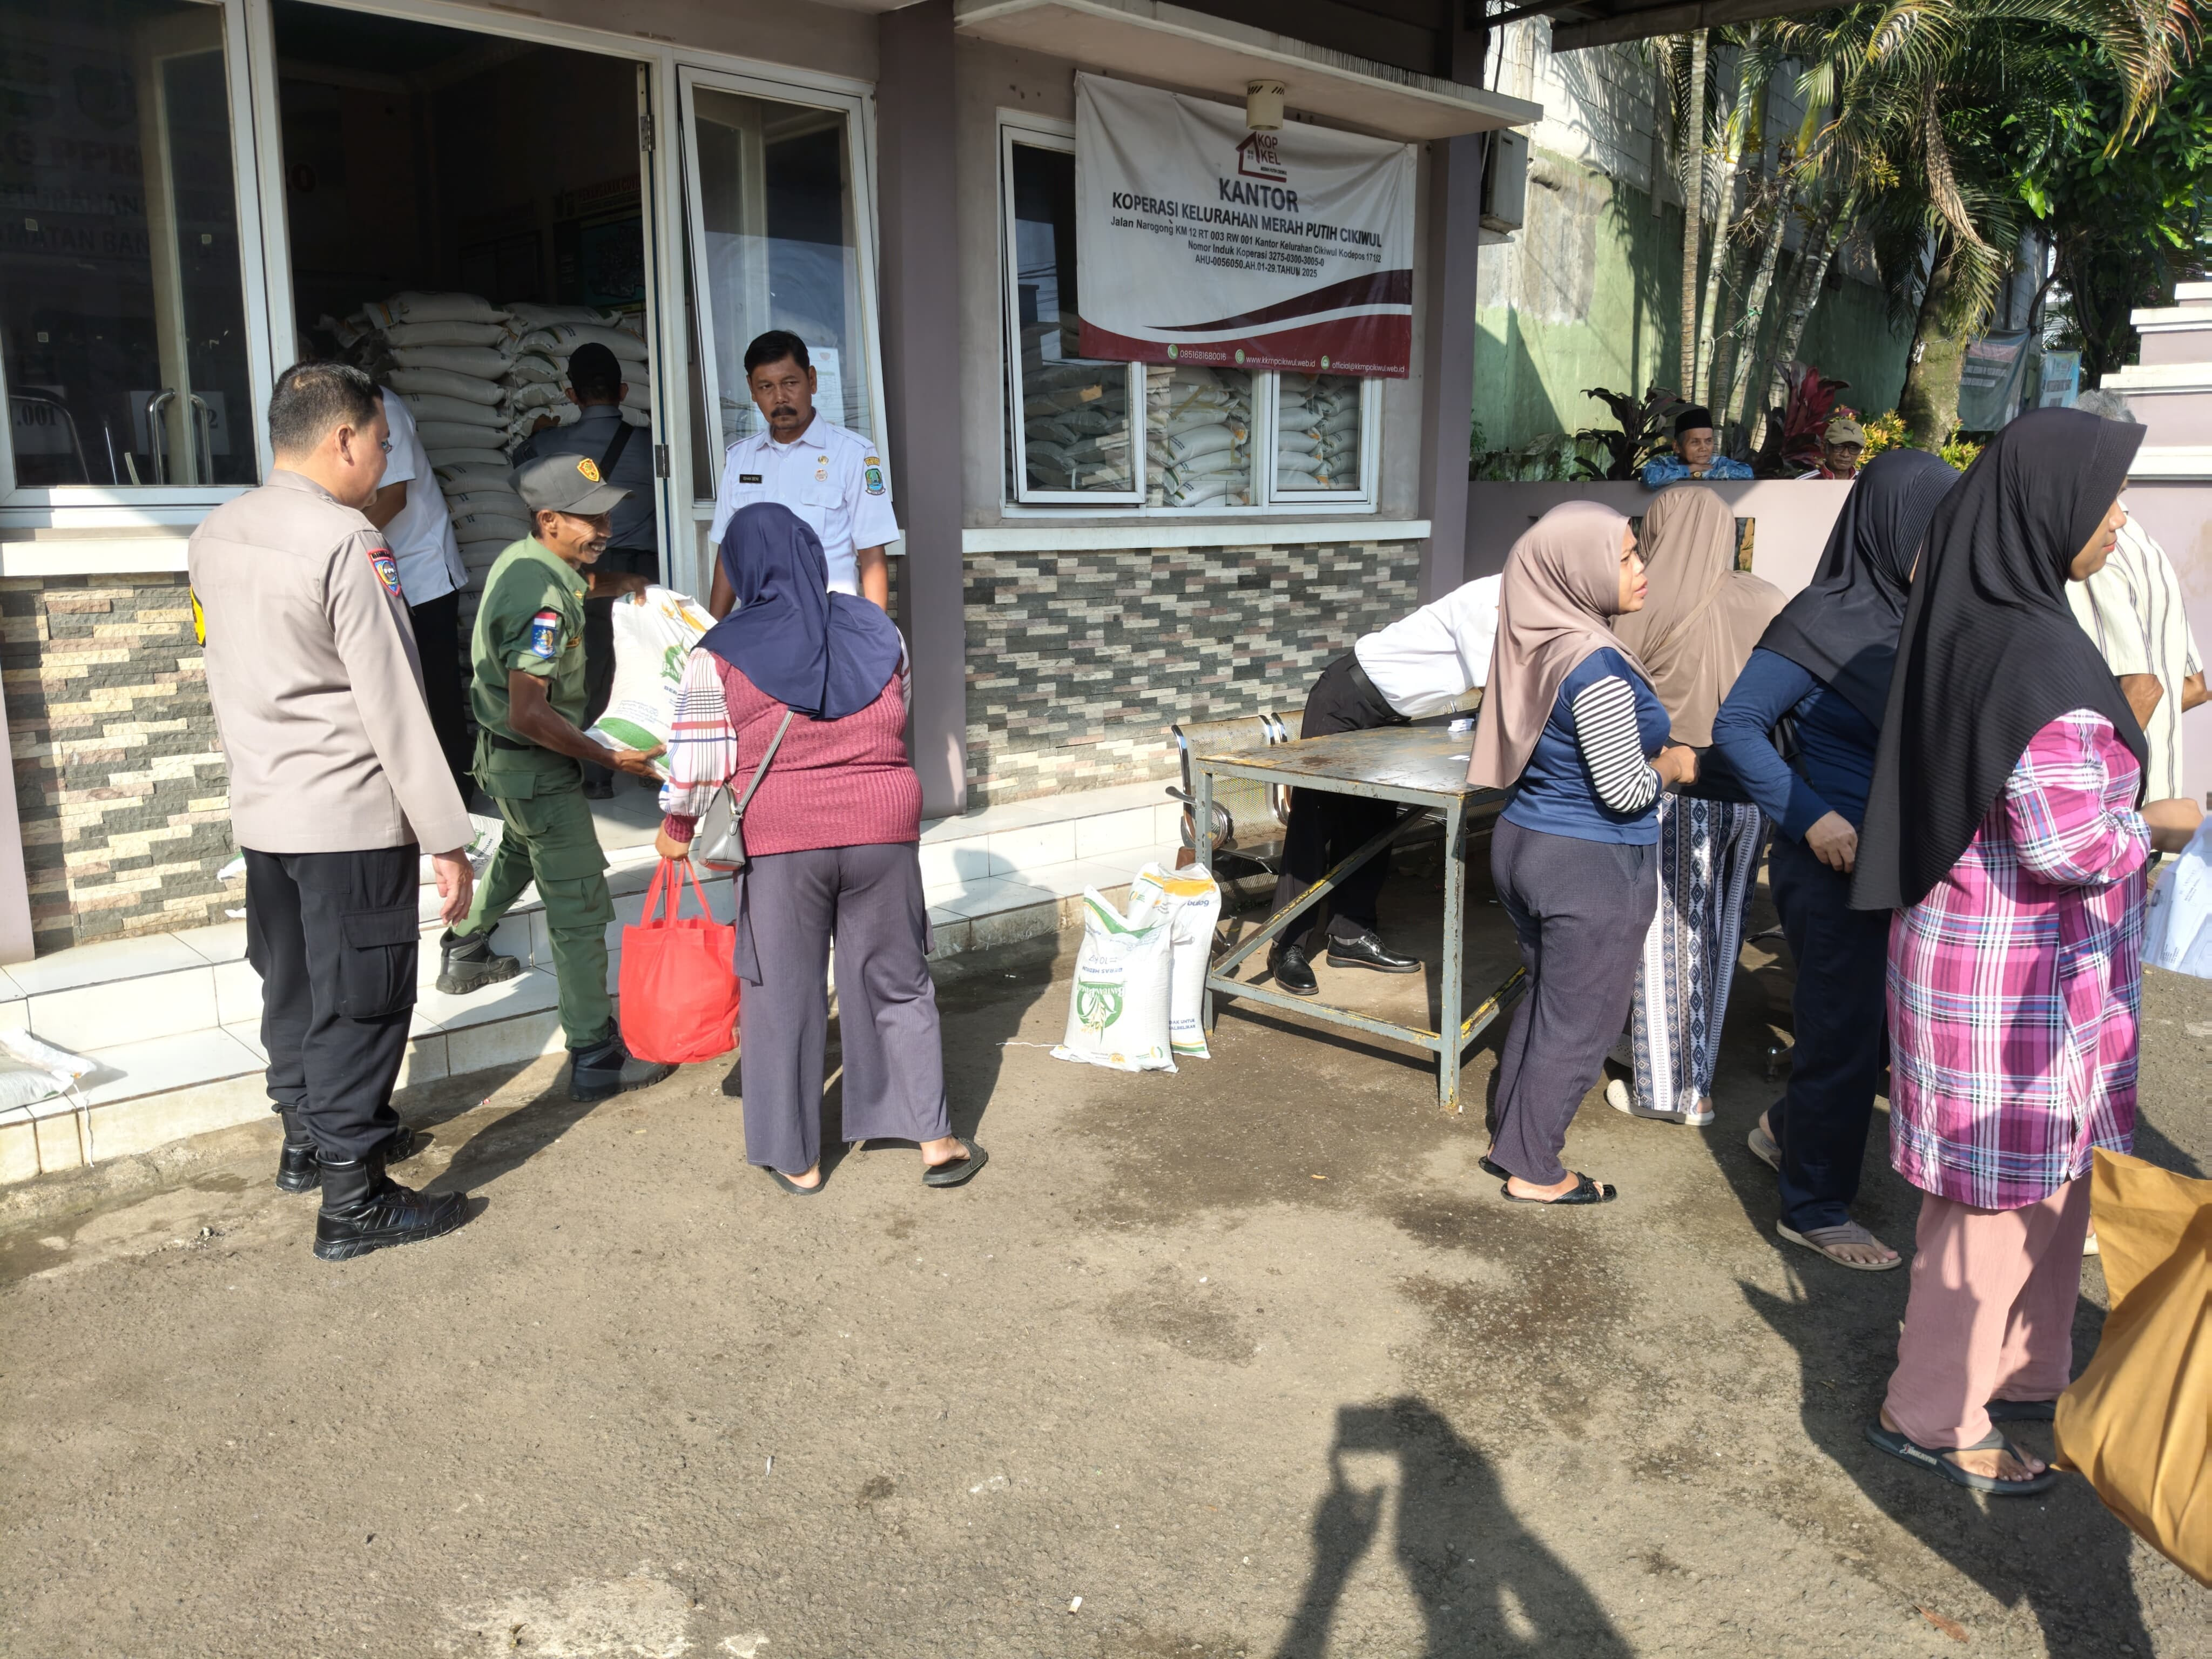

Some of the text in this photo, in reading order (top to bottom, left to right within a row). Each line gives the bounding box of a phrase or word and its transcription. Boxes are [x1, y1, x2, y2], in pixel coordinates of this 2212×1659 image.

[1257, 134, 1278, 149] KOP
[1260, 149, 1281, 165] KEL
[1219, 178, 1299, 213] KANTOR
[1112, 192, 1382, 248] KOPERASI KELURAHAN MERAH PUTIH CIKIWUL
[1111, 217, 1134, 228] Jalan
[1136, 219, 1174, 235] Narogong
[1176, 225, 1187, 235] KM
[1189, 227, 1197, 237] 12
[1198, 229, 1209, 239] RT
[1210, 231, 1224, 241] 003
[1226, 233, 1239, 242] RW
[1240, 235, 1253, 245] 001
[1255, 237, 1278, 248] Kantor
[1280, 240, 1312, 253] Kelurahan
[1314, 245, 1337, 257] Cikiwul
[1339, 248, 1365, 261] Kodepos
[1188, 240, 1324, 267] Nomor Induk Koperasi 3275-0300-3005-0
[1196, 254, 1317, 278] AHU-0056050.AH.01-29.TAHUN 2025
[1180, 350, 1226, 361] 0851681680016
[1246, 356, 1316, 368] www.kkmpcikiwul.web.id
[1332, 361, 1405, 373] official@kkmpcikiwul.web.id
